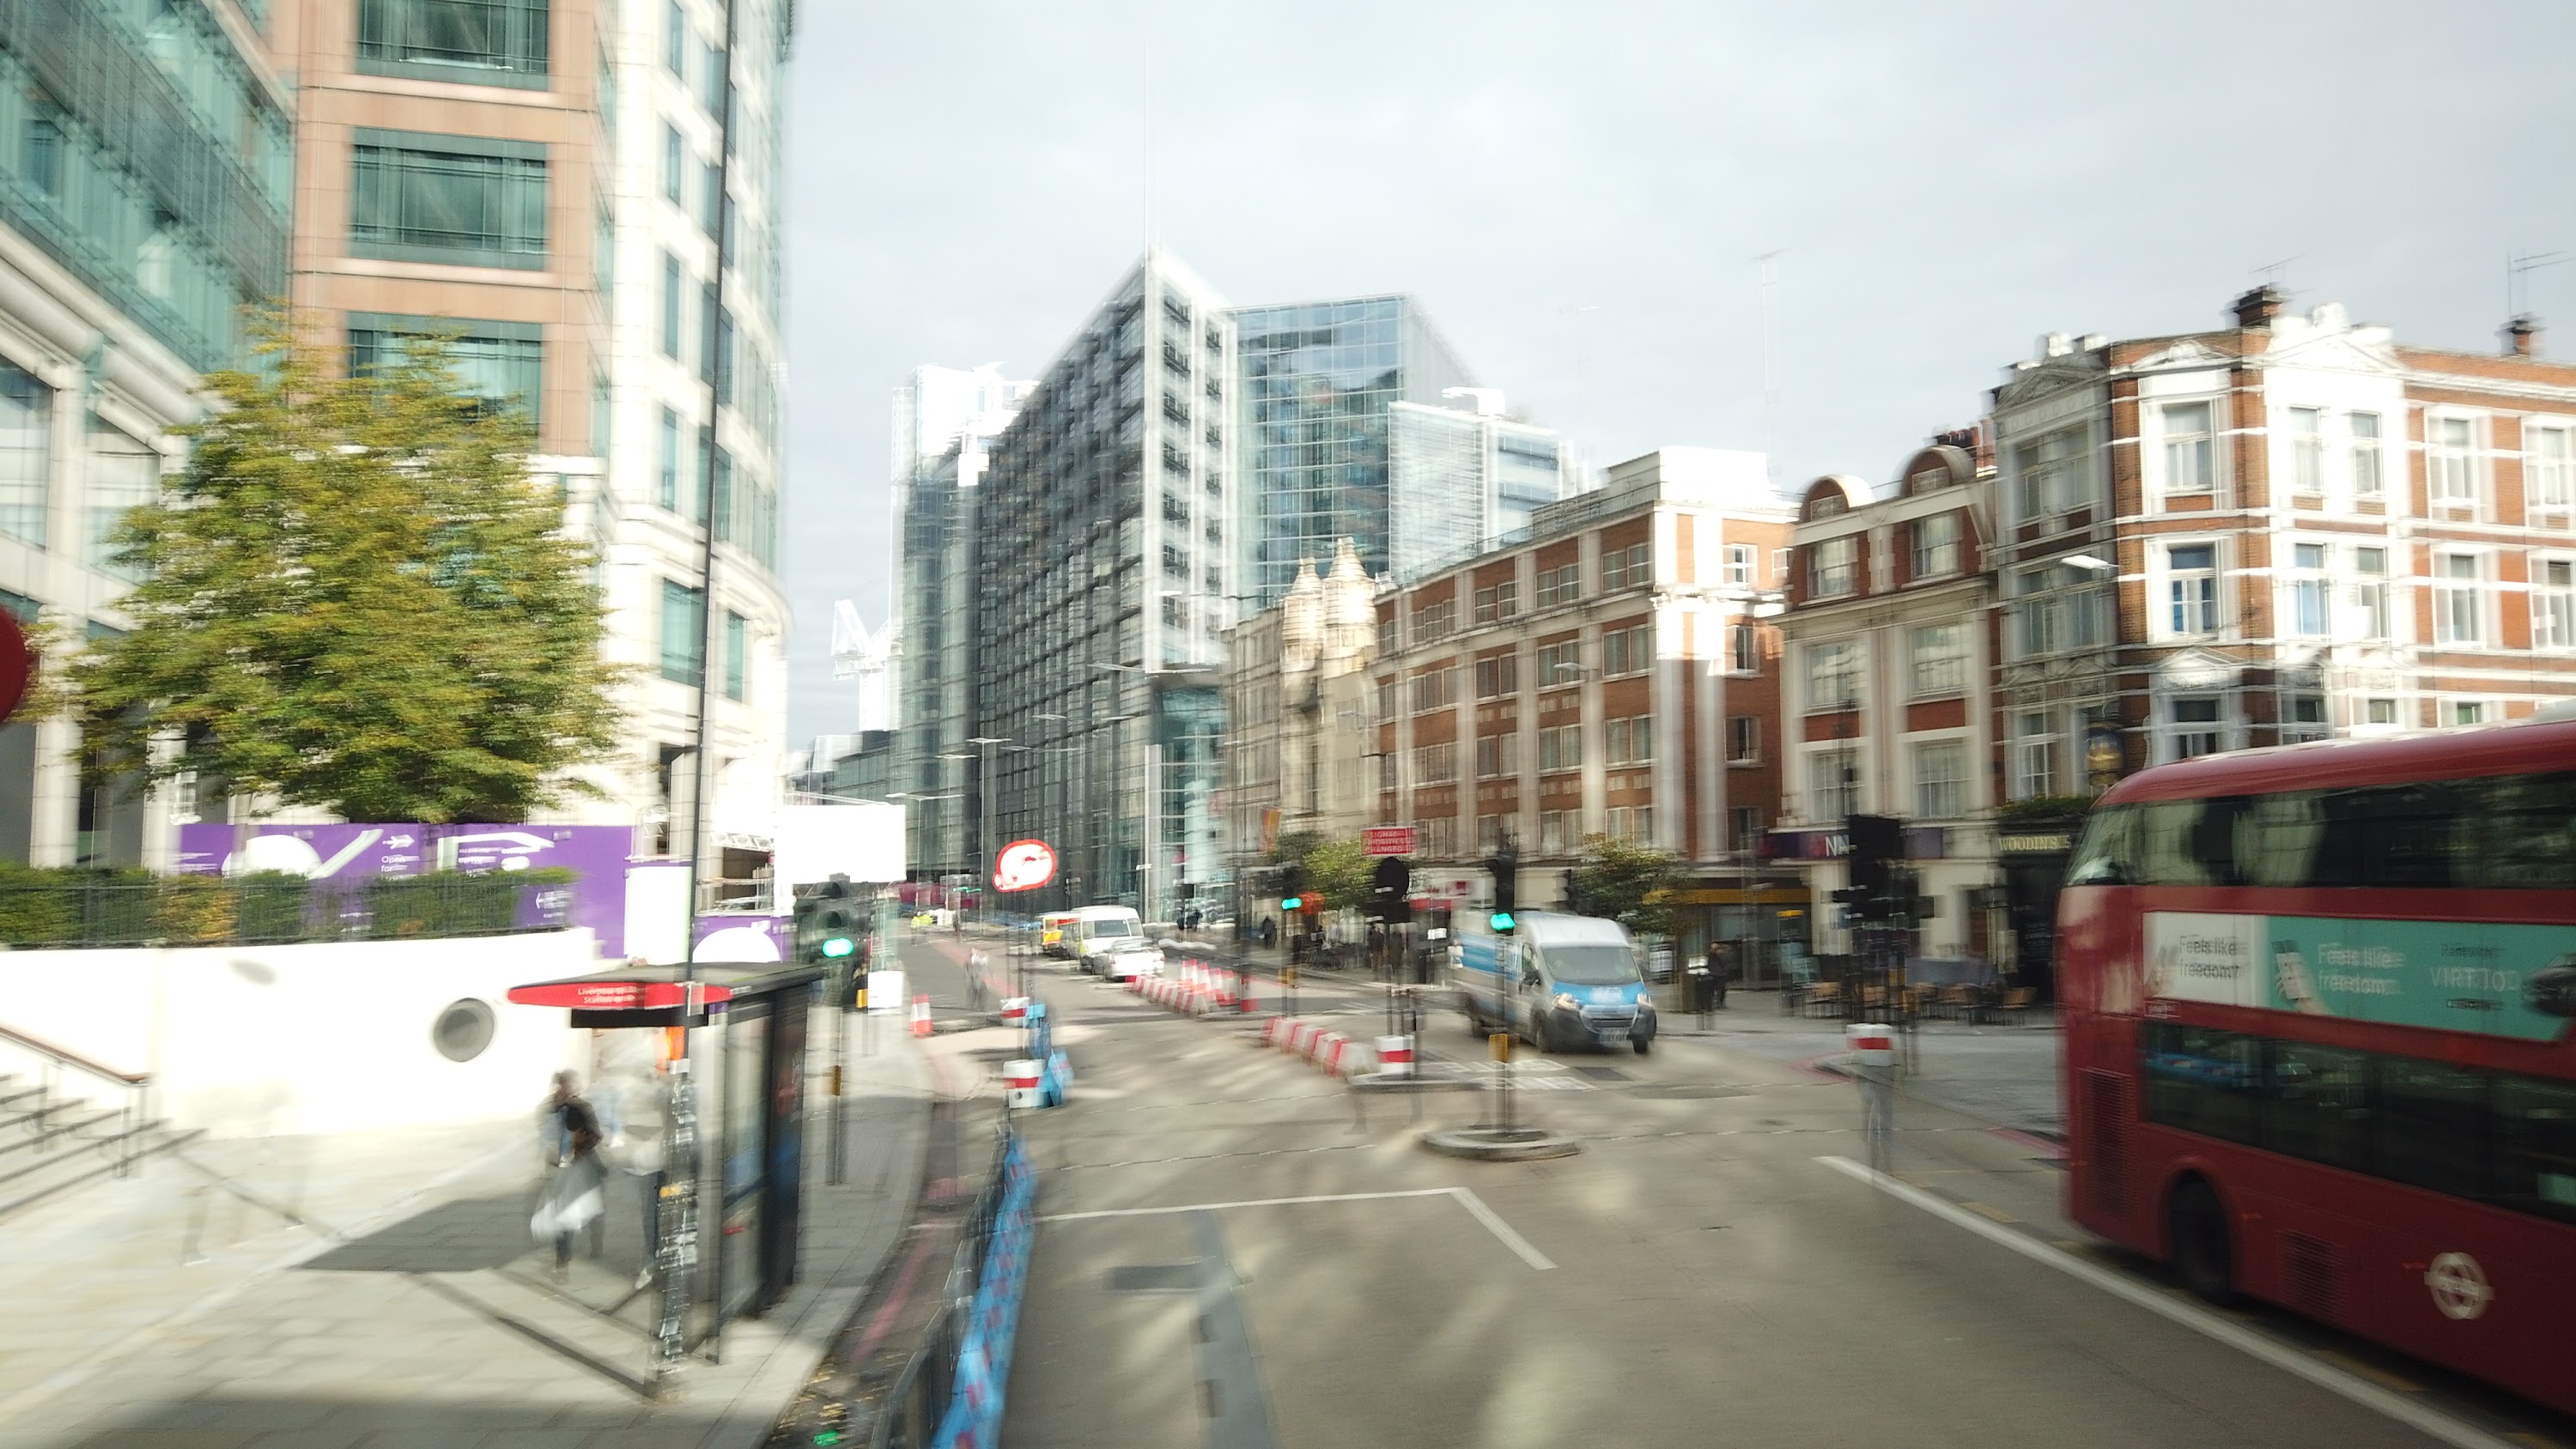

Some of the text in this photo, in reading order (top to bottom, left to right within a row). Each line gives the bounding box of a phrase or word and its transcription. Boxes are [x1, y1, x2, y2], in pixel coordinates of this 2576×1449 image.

[1363, 838, 1405, 846] PRIORITIES
[1364, 846, 1403, 854] CHANGED
[381, 855, 408, 864] Open
[2179, 935, 2238, 957] Feels like
[577, 987, 614, 997] Liverpool
[584, 996, 612, 1004] Station
